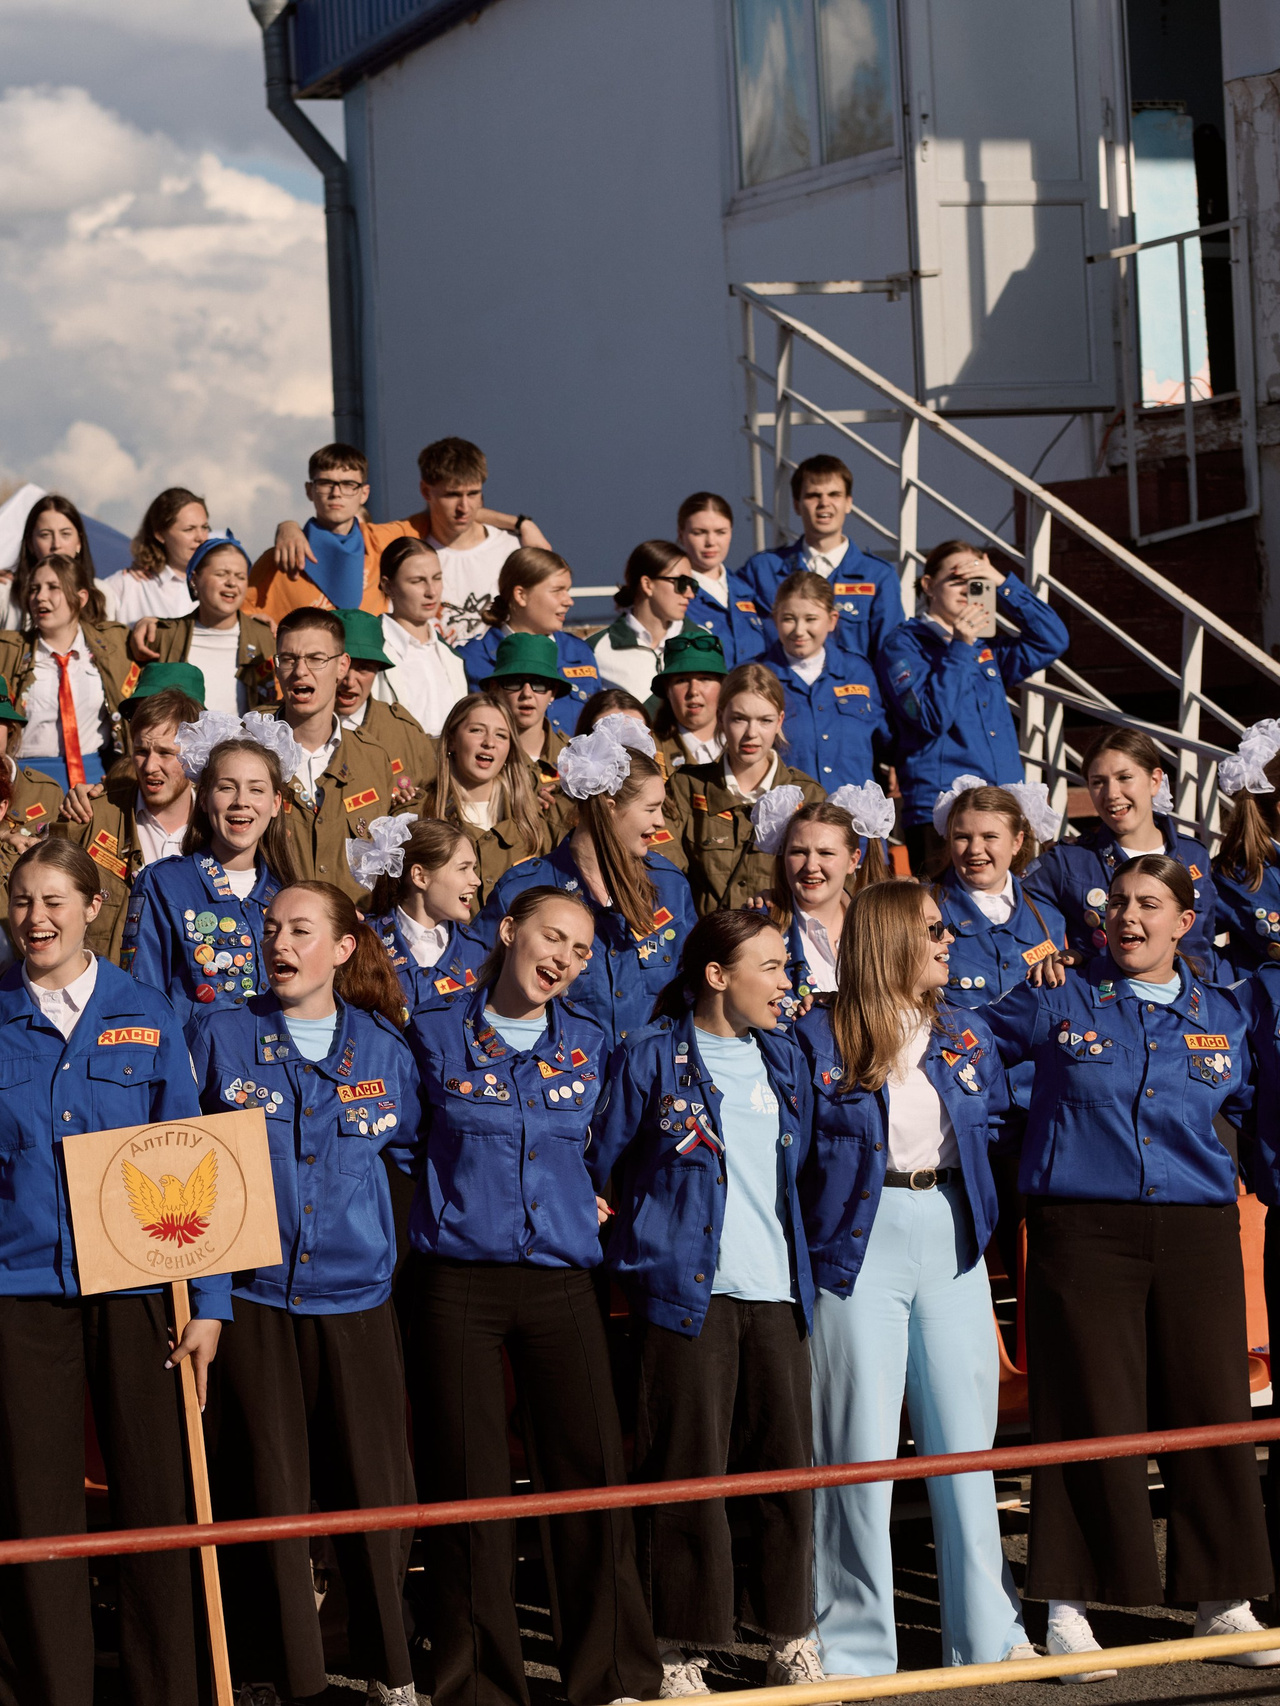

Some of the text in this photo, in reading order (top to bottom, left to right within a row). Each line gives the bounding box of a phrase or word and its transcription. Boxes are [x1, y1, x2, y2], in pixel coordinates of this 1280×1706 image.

[117, 1029, 155, 1041] ЛСО
[129, 1131, 203, 1157] АлтГПУ
[146, 1240, 216, 1269] Феникс
